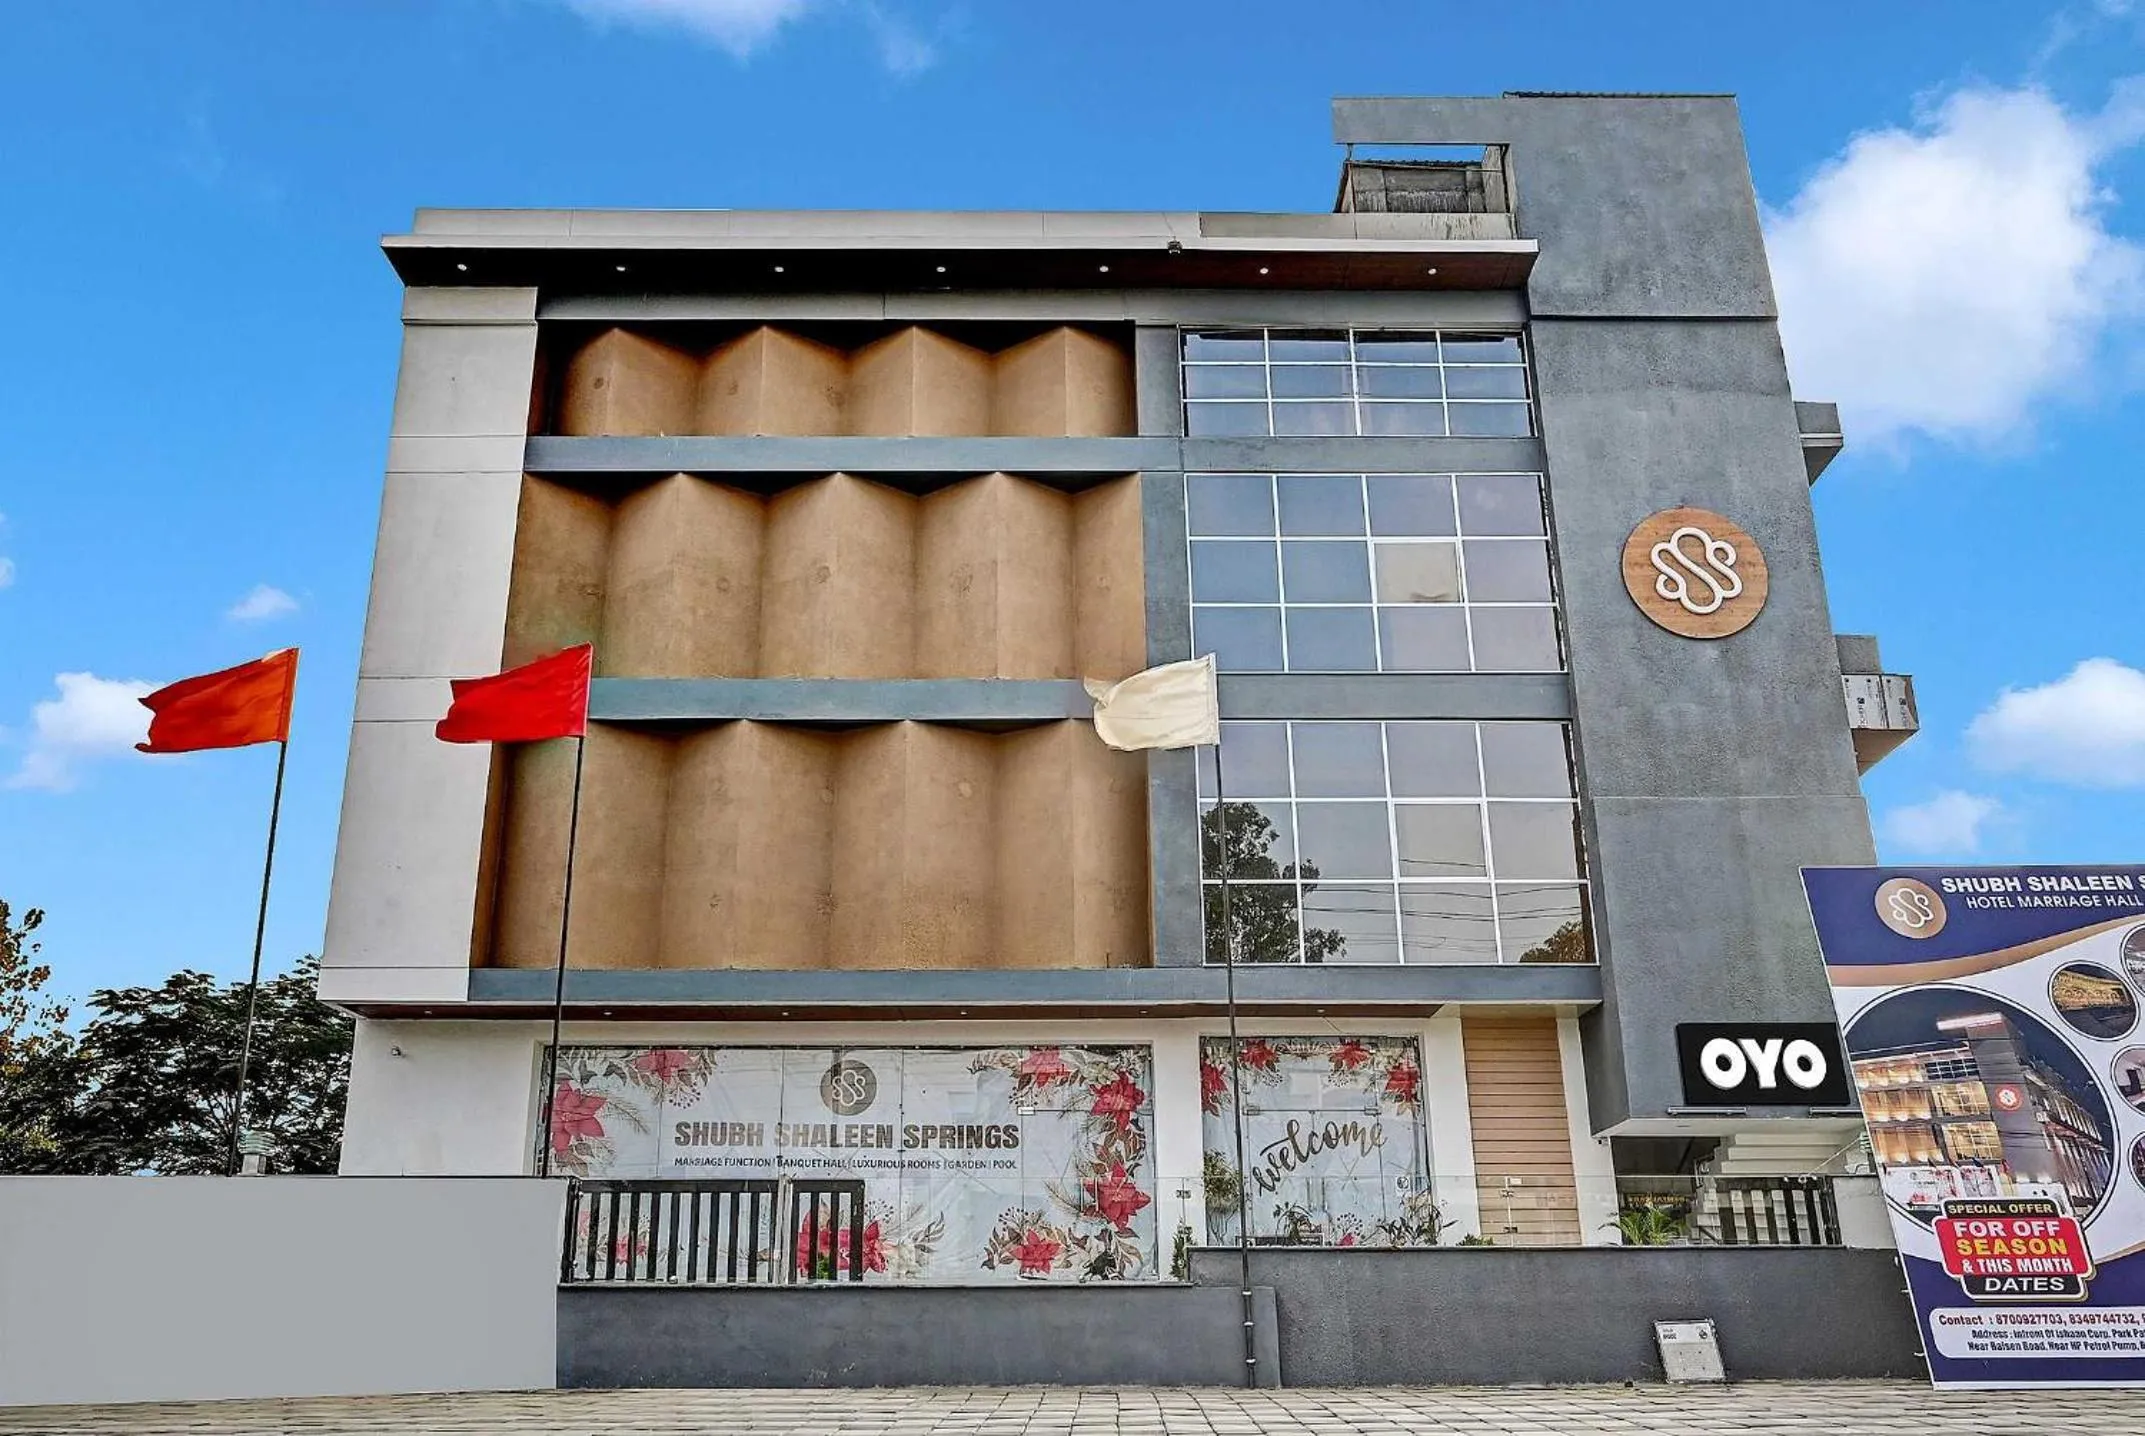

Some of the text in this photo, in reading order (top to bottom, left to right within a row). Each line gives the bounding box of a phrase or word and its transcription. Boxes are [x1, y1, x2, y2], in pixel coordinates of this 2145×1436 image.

[1941, 877, 2022, 893] SHUBH
[2027, 875, 2134, 892] SHALEEN
[1966, 894, 2144, 909] HOTEL MARRIAGE HALL
[1700, 1038, 1827, 1090] OYO
[675, 1121, 1019, 1149] SHUBH SHALEEN SPRINGS
[725, 1157, 771, 1167] FUNCTION
[777, 1157, 821, 1168] BANQUET
[852, 1159, 905, 1169] LUXURIOUS
[907, 1159, 941, 1169] ROOMS
[993, 1160, 1017, 1169] POOL
[1948, 1203, 2053, 1214] SPECIAL OFFER
[1953, 1220, 2060, 1237] FOR OFF
[1956, 1238, 2068, 1256] SEASON
[1963, 1258, 2073, 1273] & THIS MONTH
[1984, 1277, 2065, 1291] DATES
[1938, 1314, 1984, 1325] Contact
